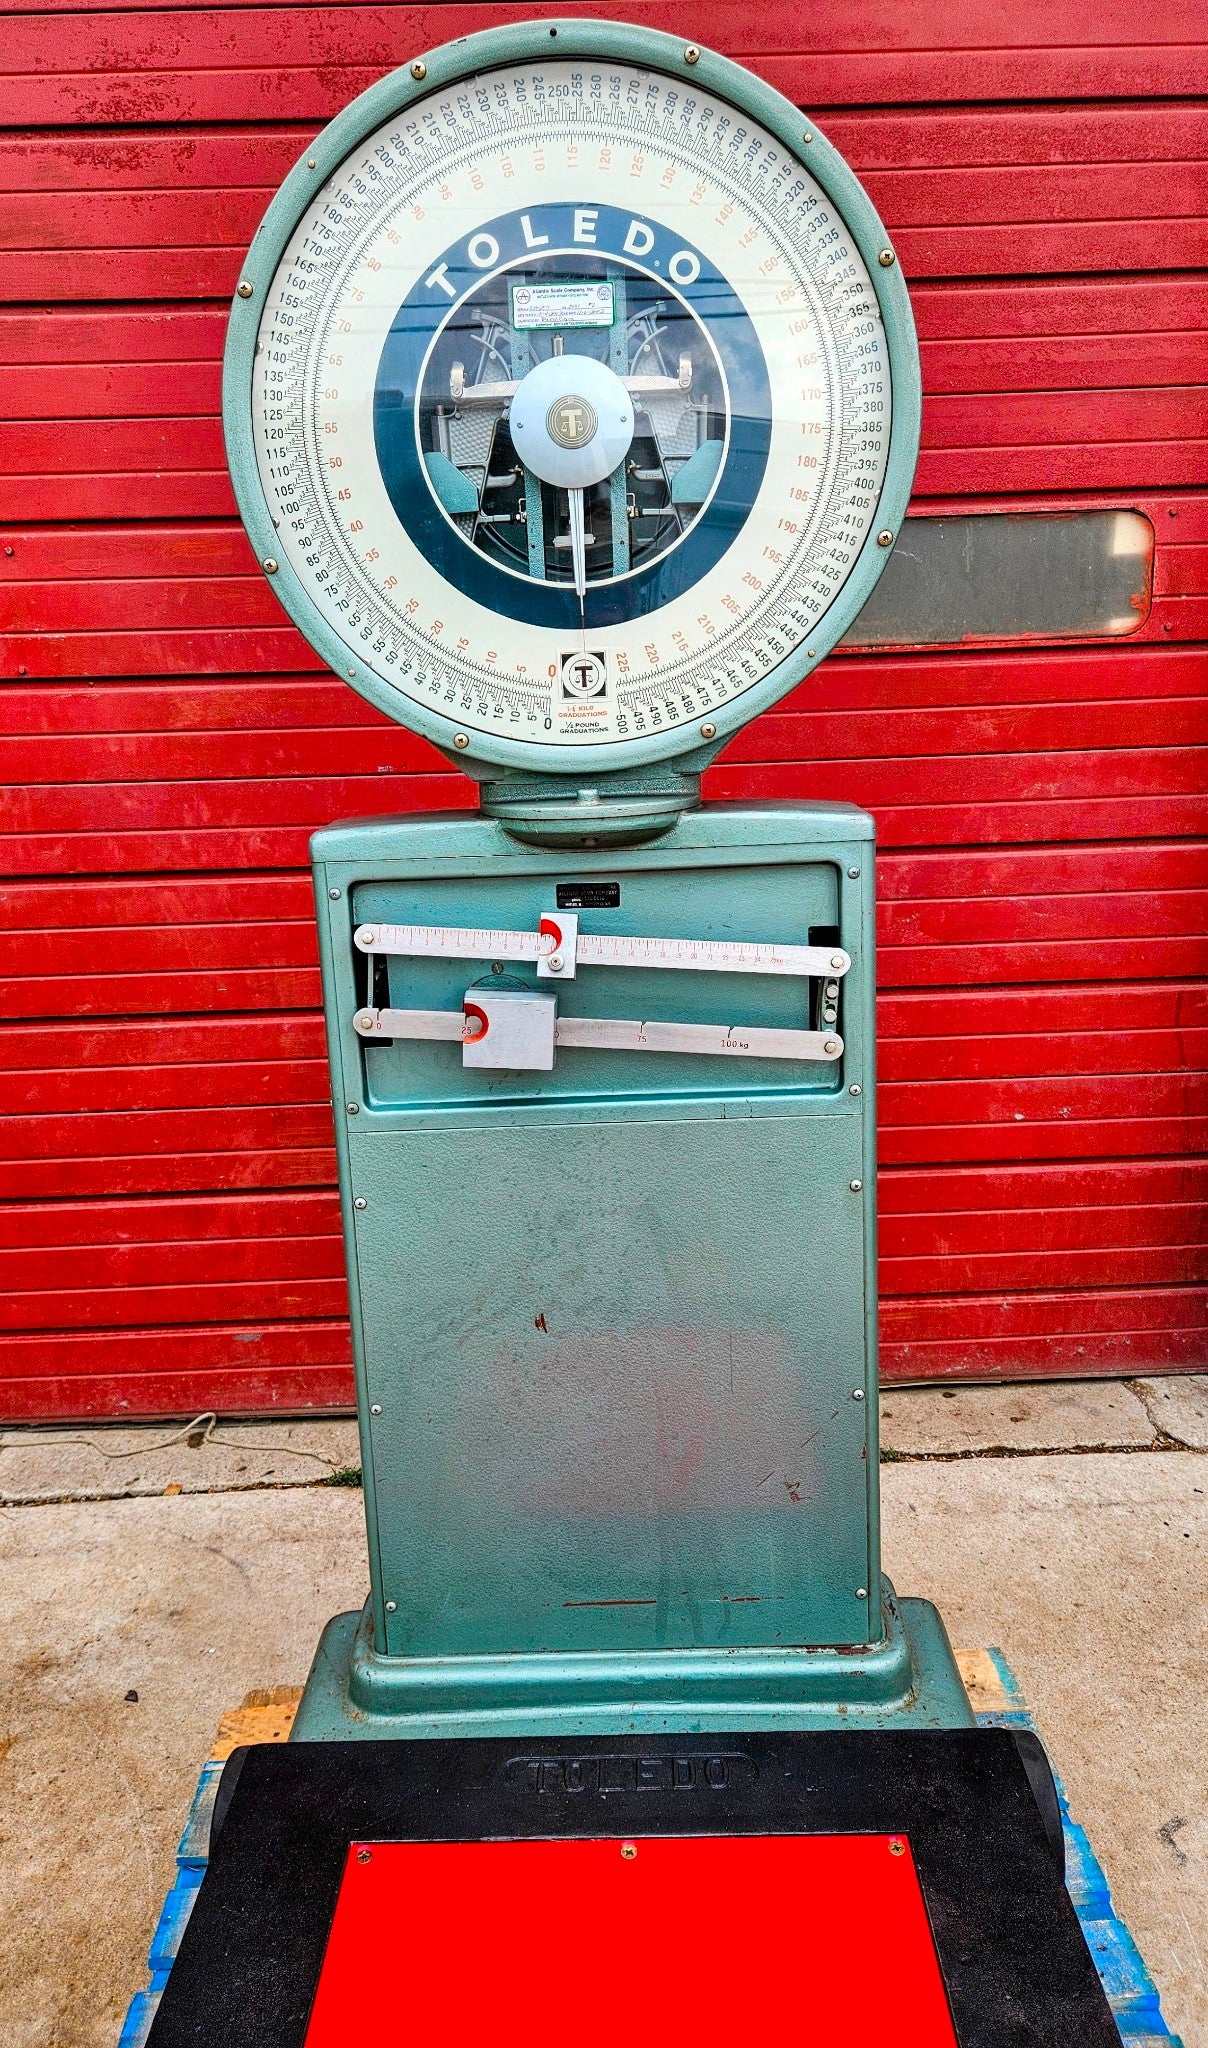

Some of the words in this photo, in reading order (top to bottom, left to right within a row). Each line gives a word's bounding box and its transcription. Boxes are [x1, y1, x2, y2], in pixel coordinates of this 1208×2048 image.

[513, 78, 527, 102] 240
[532, 76, 546, 101] 245
[548, 84, 569, 98] 250
[571, 73, 583, 98] 255
[589, 74, 602, 99] 260
[608, 75, 621, 100] 265
[626, 79, 641, 105] 270
[474, 87, 491, 112] 230
[493, 82, 509, 107] 235
[644, 84, 660, 111] 275
[456, 94, 474, 119] 225
[662, 91, 679, 117] 280
[439, 102, 457, 127] 220
[696, 107, 714, 133] 290
[421, 112, 441, 137] 215
[405, 121, 425, 146] 210
[728, 127, 747, 152] 300
[374, 145, 394, 168] 200
[743, 137, 763, 162] 305
[499, 155, 515, 178] 105
[599, 148, 611, 170] 120
[629, 155, 644, 178] 125
[758, 151, 778, 174] 310
[361, 159, 381, 181] 195
[468, 167, 484, 190] 100
[660, 167, 677, 190] 130
[772, 164, 792, 188] 315
[347, 173, 367, 195] 190
[785, 180, 805, 203] 320
[334, 188, 355, 209] 185
[796, 194, 818, 217] 325
[323, 204, 343, 225] 180
[807, 212, 829, 233] 330
[312, 220, 333, 240] 175
[818, 227, 840, 249] 335
[302, 237, 323, 257] 170
[425, 209, 700, 298] TOLEDO
[827, 246, 848, 265] 340
[294, 255, 314, 273] 165
[286, 272, 307, 291] 160
[279, 291, 300, 309] 155
[842, 284, 863, 301] 350
[274, 310, 294, 327] 150
[848, 303, 870, 319] 355
[339, 318, 352, 334] 70
[853, 321, 875, 338] 360
[270, 330, 290, 346] 145
[267, 350, 287, 364] 140
[857, 340, 879, 357] 365
[329, 354, 343, 366] 65
[860, 360, 882, 375] 370
[264, 369, 283, 383] 135
[263, 389, 283, 402] 130
[324, 388, 338, 400] 60
[862, 381, 883, 395] 375
[263, 409, 284, 421] 125
[863, 400, 884, 413] 380
[324, 421, 338, 435] 55
[801, 422, 822, 435] 175
[861, 421, 883, 433] 385
[266, 446, 287, 460] 115
[860, 440, 881, 452] 390
[328, 456, 343, 469] 50
[797, 455, 818, 469] 180
[857, 458, 879, 471] 395
[274, 483, 295, 498] 105
[854, 477, 875, 491] 400
[338, 488, 352, 502] 45
[789, 487, 810, 502] 185
[849, 495, 871, 509] 405
[280, 501, 300, 516] 100
[290, 518, 305, 532] 95
[348, 519, 364, 534] 40
[777, 518, 798, 534] 190
[843, 513, 864, 529] 410
[297, 536, 312, 550] 90
[836, 530, 858, 547] 415
[305, 552, 320, 567] 85
[365, 547, 380, 565] 35
[762, 544, 783, 564] 195
[829, 548, 850, 564] 420
[315, 569, 330, 583] 80
[741, 572, 762, 590] 200
[821, 564, 842, 581] 425
[323, 583, 339, 598] 75
[383, 575, 398, 590] 30
[811, 580, 831, 597] 430
[334, 599, 350, 612] 70
[405, 597, 419, 614] 25
[720, 594, 741, 614] 205
[801, 595, 822, 613] 435
[347, 613, 360, 627] 65
[427, 617, 444, 635] 20
[697, 614, 715, 635] 210
[790, 609, 809, 628] 440
[359, 626, 372, 641] 60
[779, 623, 799, 641] 445
[372, 638, 386, 653] 55
[456, 636, 470, 651] 15
[671, 630, 689, 652] 215
[766, 636, 785, 655] 450
[385, 650, 399, 665] 50
[485, 651, 498, 664] 10
[644, 642, 661, 665] 220
[754, 648, 773, 667] 455
[399, 661, 412, 675] 45
[516, 665, 527, 673] 5
[548, 664, 556, 677] 0
[615, 652, 630, 674] 225
[740, 660, 758, 679] 460
[414, 671, 427, 686] 40
[428, 679, 441, 695] 35
[726, 669, 744, 689] 465
[443, 689, 457, 703] 30
[696, 687, 712, 706] 475
[712, 678, 728, 698] 470
[460, 696, 472, 710] 25
[476, 702, 489, 716] 20
[664, 700, 680, 721] 485
[681, 694, 696, 714] 480
[492, 706, 505, 719] 15
[509, 708, 521, 723] 10
[527, 714, 538, 722] 5
[633, 711, 647, 731] 495
[649, 706, 663, 726] 490
[543, 717, 552, 731] 0
[560, 726, 609, 734] GRADUATIONS
[616, 713, 629, 734] 500
[461, 1027, 472, 1035] 25
[720, 1040, 738, 1048] 100
[527, 1758, 729, 1793] TOLEDO
